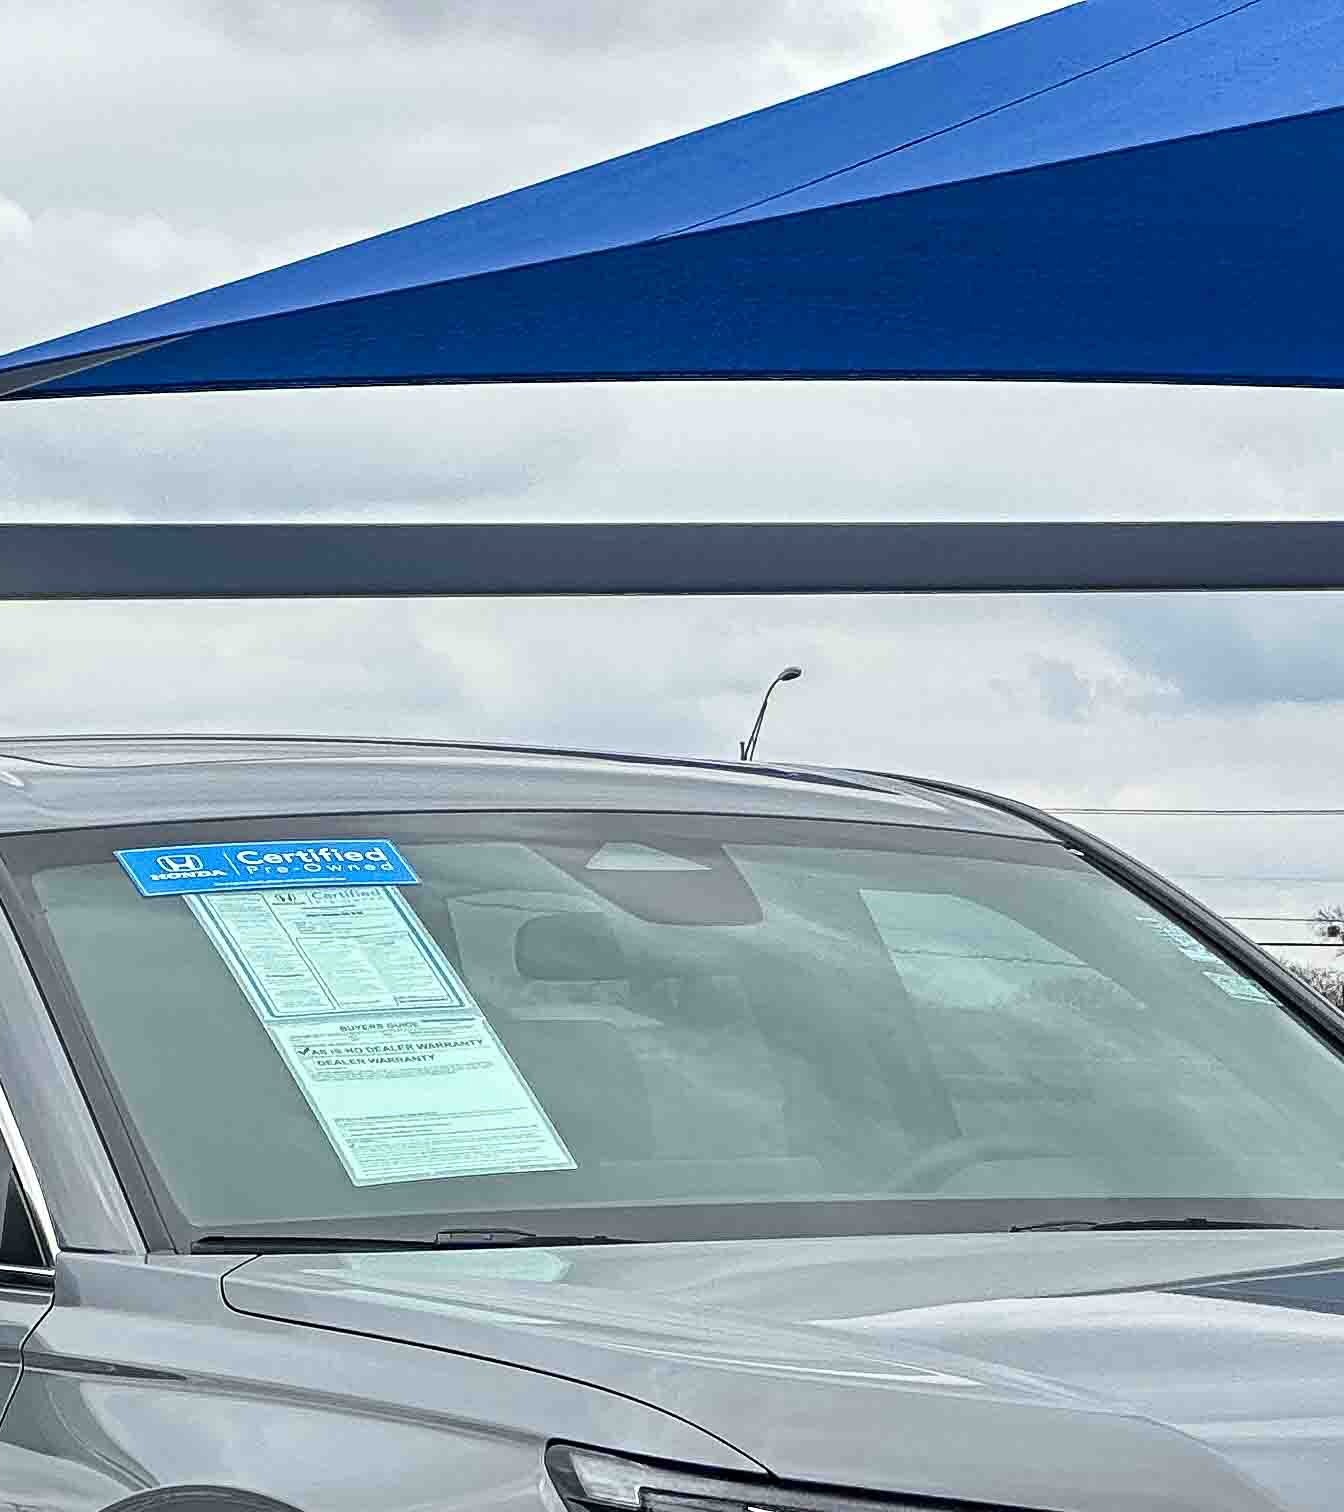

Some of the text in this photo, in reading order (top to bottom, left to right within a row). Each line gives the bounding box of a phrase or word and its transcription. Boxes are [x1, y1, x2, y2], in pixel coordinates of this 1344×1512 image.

[236, 847, 386, 866] Certified
[150, 869, 227, 881] HONDA
[246, 862, 394, 875] Pre-Owned
